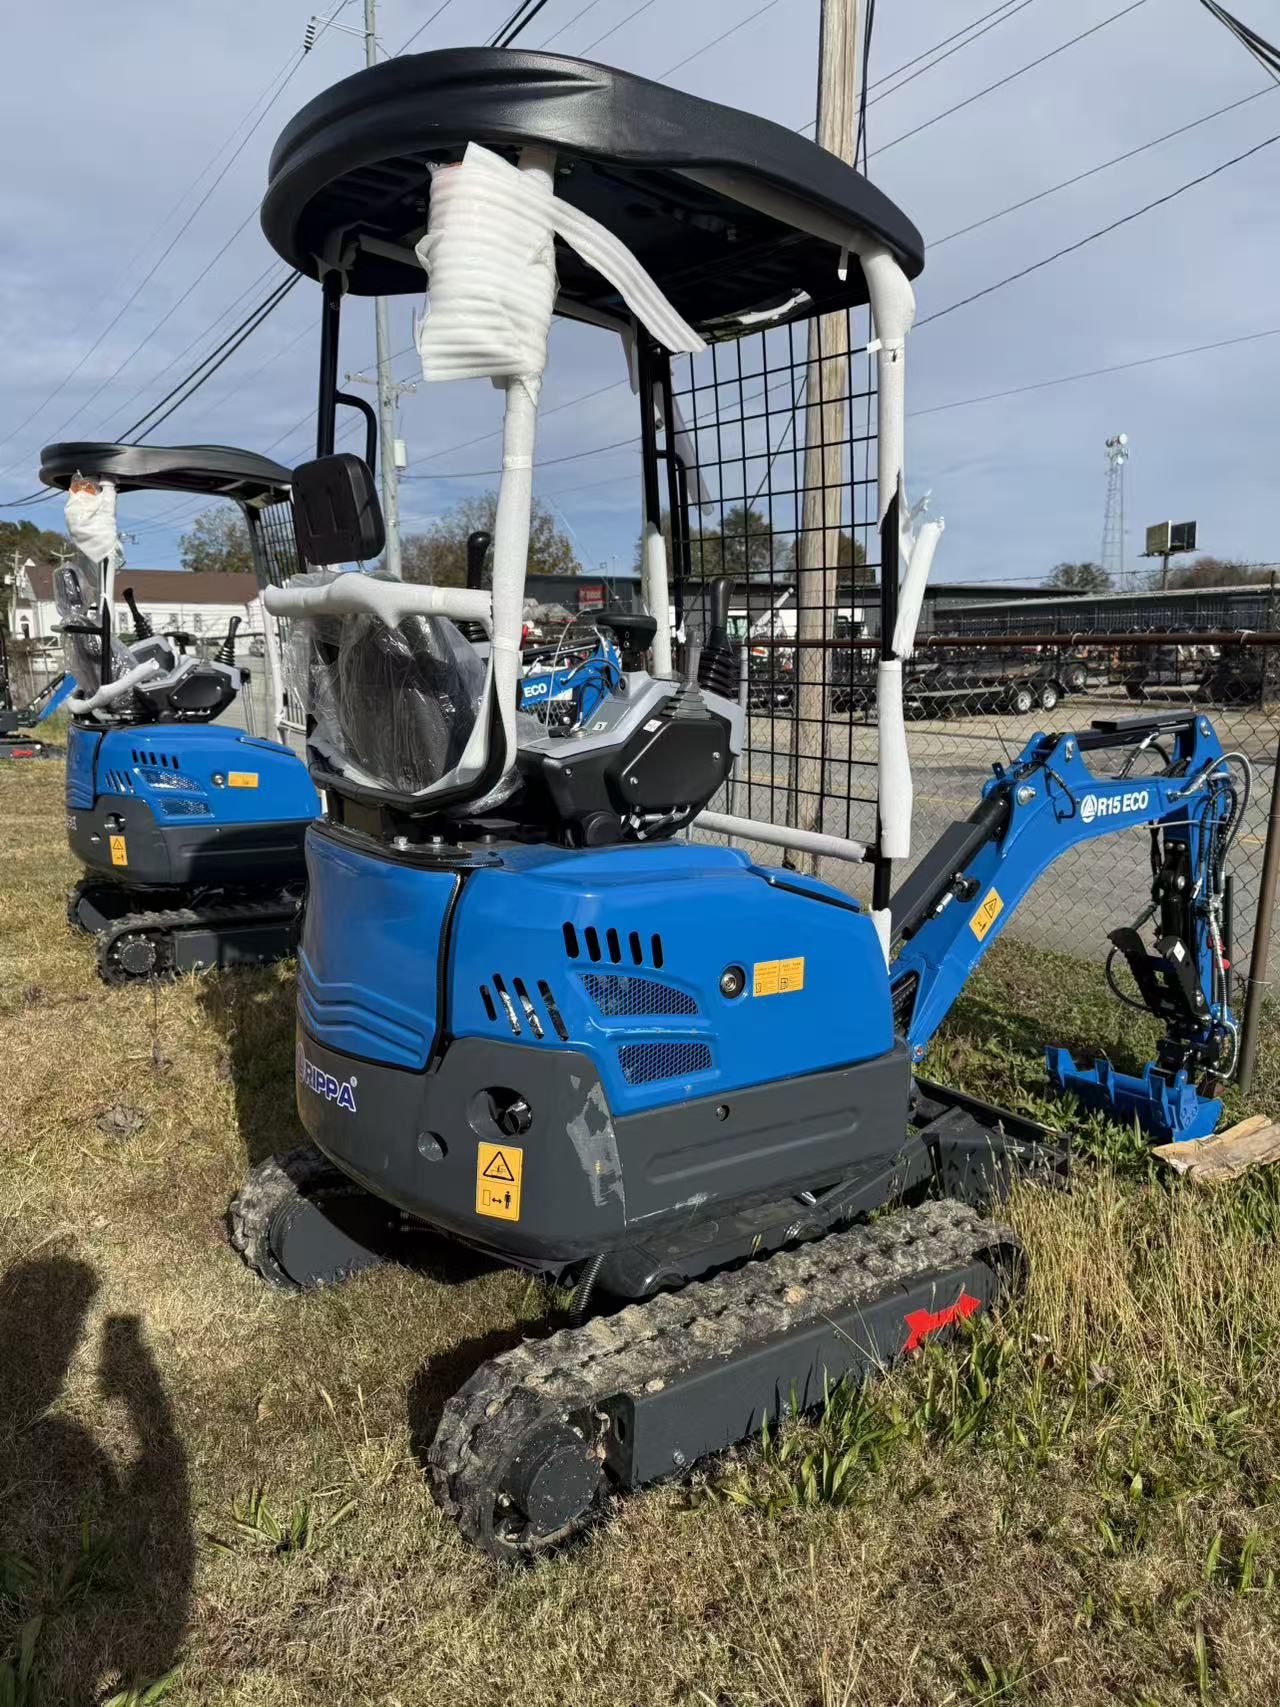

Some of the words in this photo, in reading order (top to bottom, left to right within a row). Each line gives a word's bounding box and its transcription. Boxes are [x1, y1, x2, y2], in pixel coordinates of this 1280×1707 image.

[523, 682, 548, 698] ECO
[1097, 795, 1121, 816] R15
[1122, 790, 1149, 812] ECO
